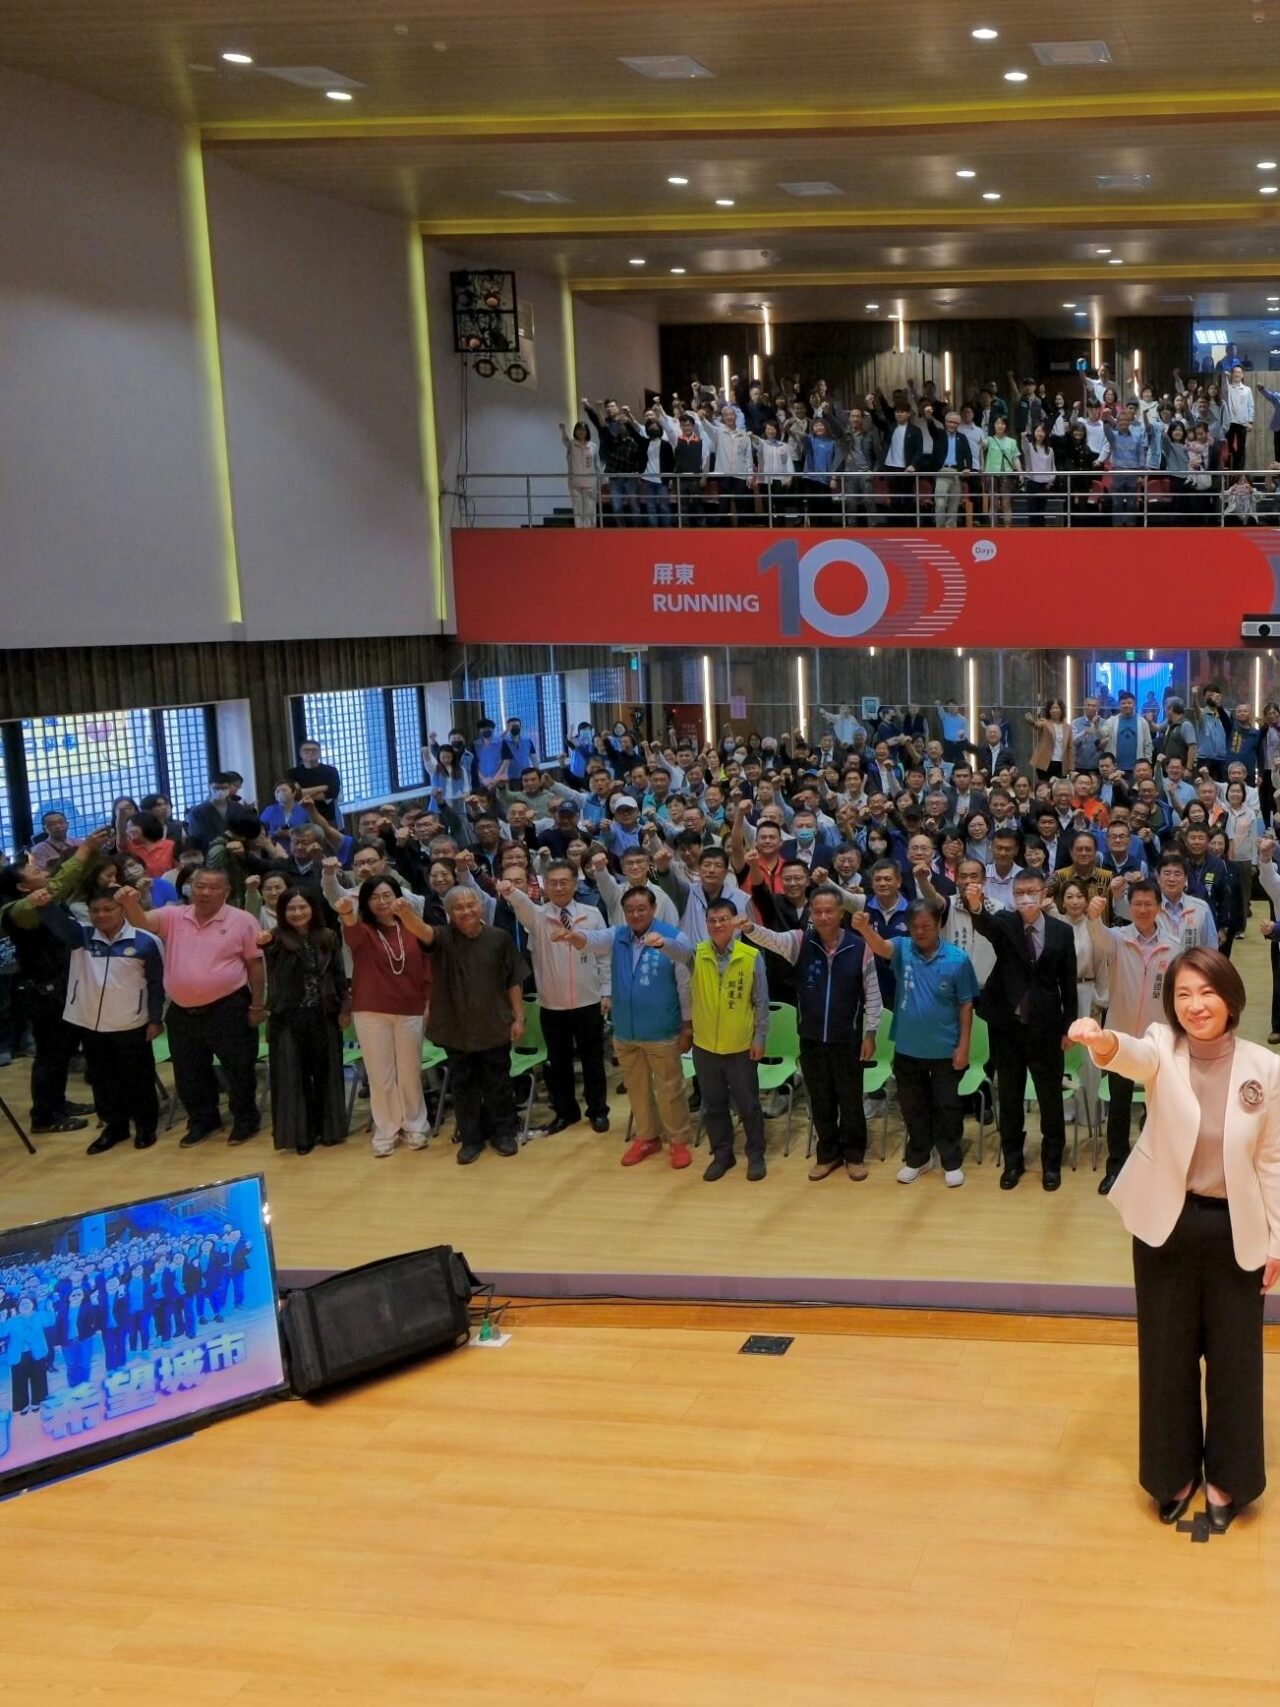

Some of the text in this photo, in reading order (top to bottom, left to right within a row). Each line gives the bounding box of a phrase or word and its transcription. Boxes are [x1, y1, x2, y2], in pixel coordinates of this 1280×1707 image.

[974, 546, 995, 556] Days
[653, 563, 695, 586] 屏東
[653, 594, 760, 613] RUNNING
[40, 1330, 249, 1440] 希望城市
